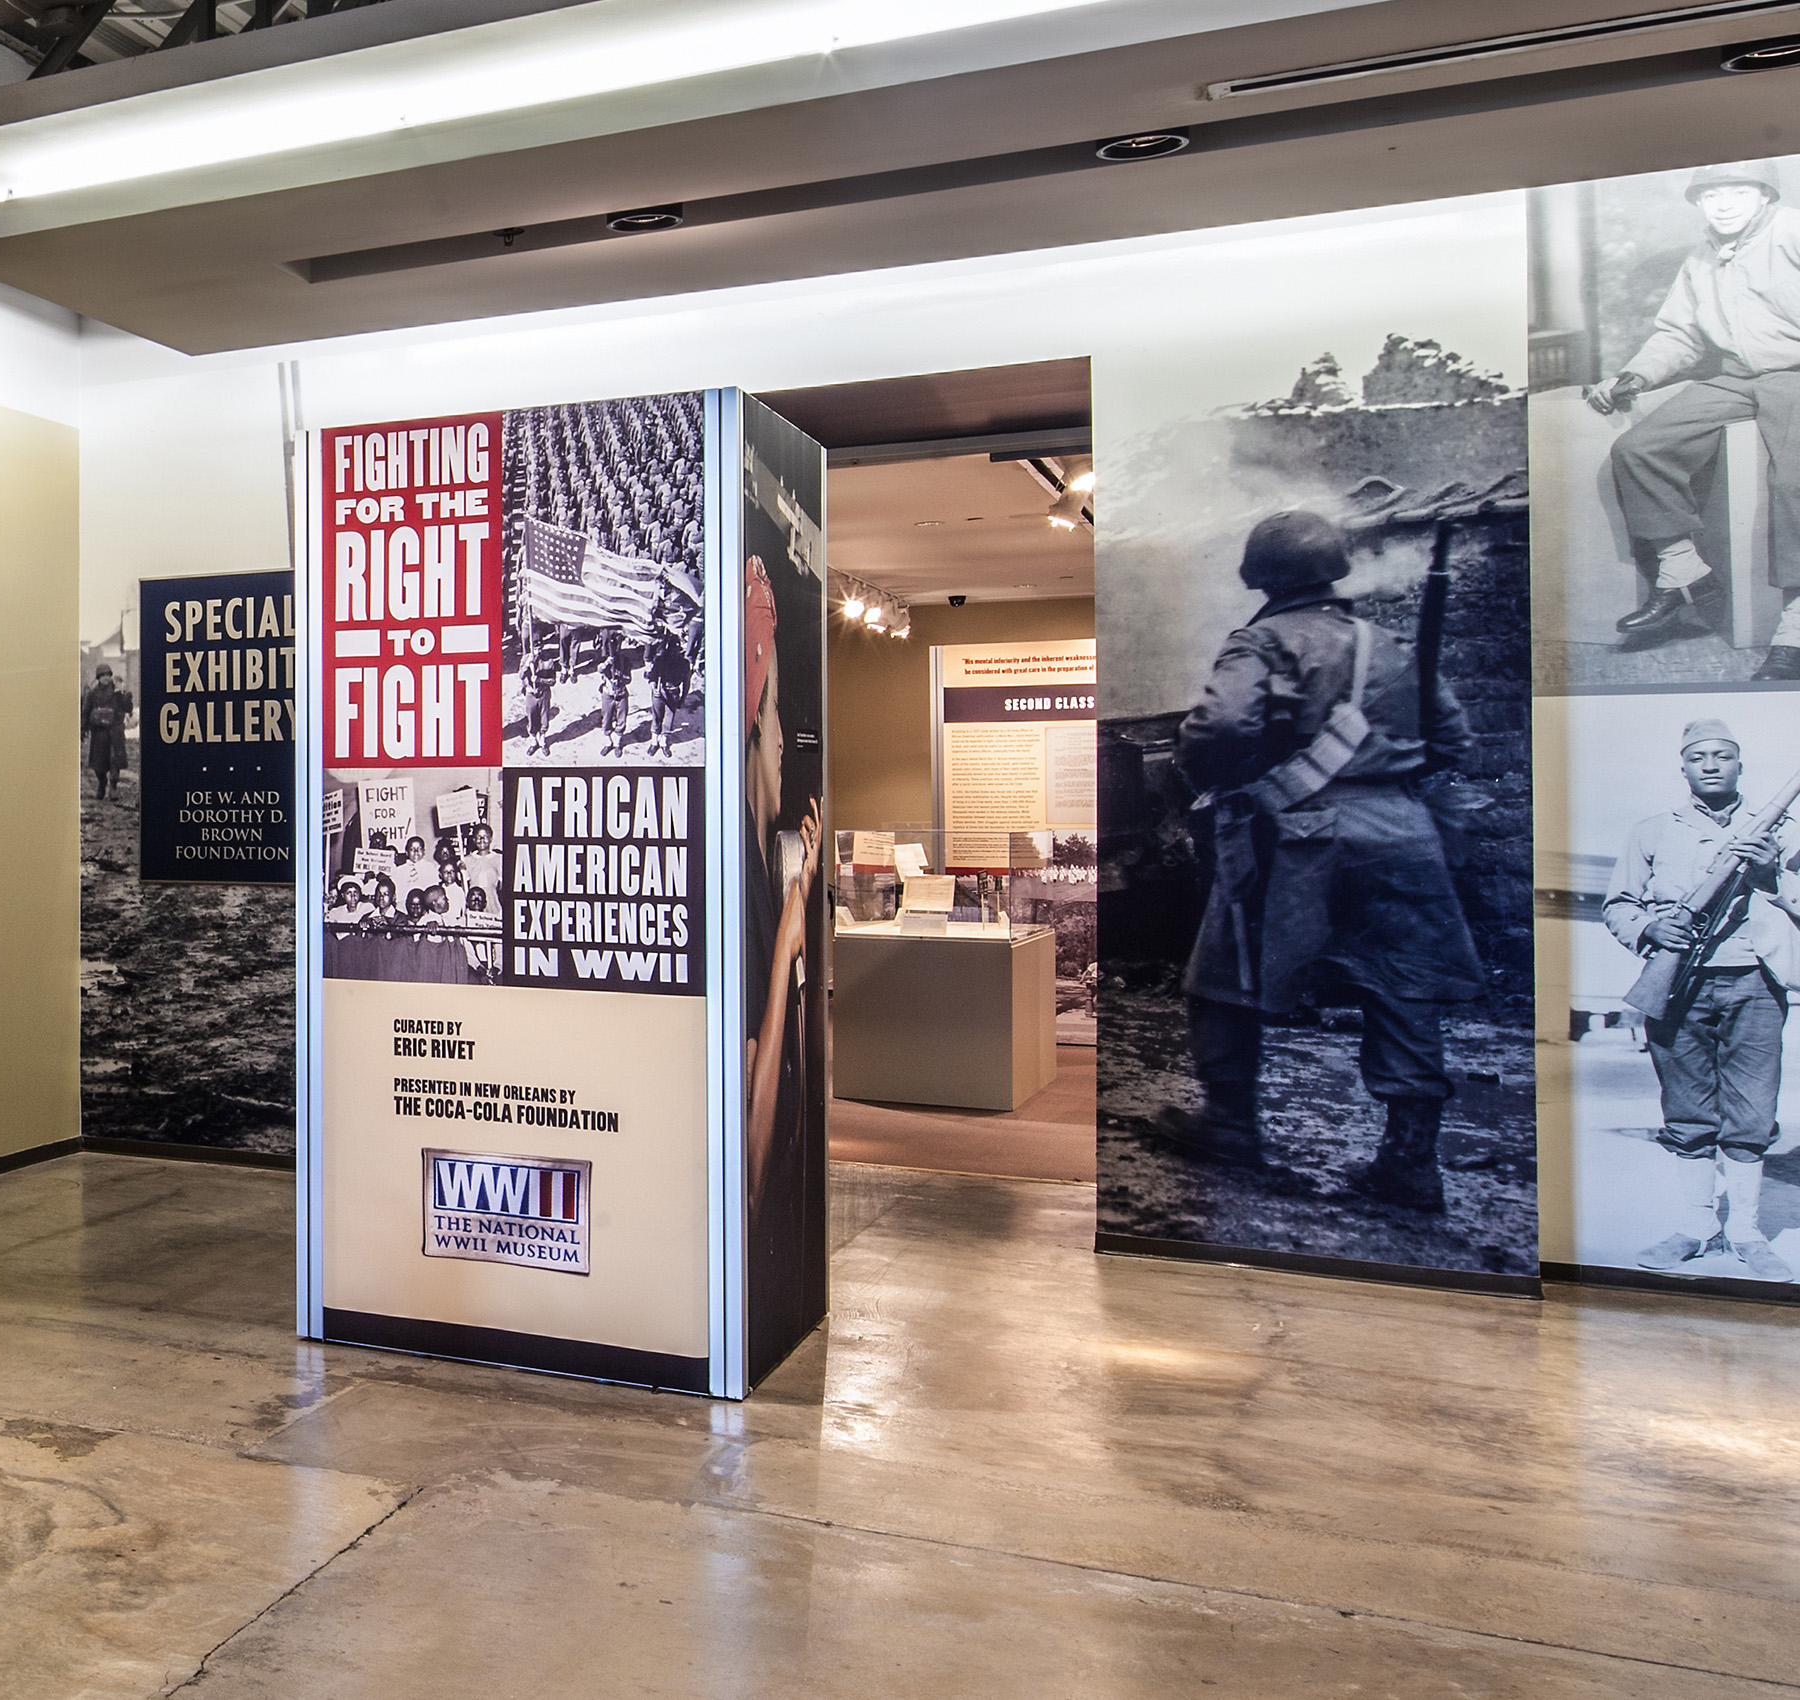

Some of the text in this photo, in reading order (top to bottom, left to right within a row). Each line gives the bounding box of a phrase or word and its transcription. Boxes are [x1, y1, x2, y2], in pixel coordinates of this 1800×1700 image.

[335, 422, 489, 493] FIGHTING
[335, 488, 488, 525] FOR THE
[335, 521, 489, 622] RIGHT
[164, 594, 295, 642] SPECIAL
[387, 628, 435, 656] TO
[166, 647, 295, 693] EXHIBIT
[335, 663, 489, 759] FIGHT
[1004, 696, 1095, 711] SECOND CLASS
[185, 790, 280, 807] JOE W. AND
[365, 786, 408, 803] FIGHT
[513, 775, 688, 839] AFRICAN
[179, 809, 287, 824] DOROTHY D.
[374, 808, 396, 819] FOR
[201, 827, 263, 843] BROWN
[175, 845, 290, 861] FOUNDATION
[513, 844, 688, 897] AMERICAN
[513, 899, 689, 947] EXPERIENCES
[514, 946, 689, 984] IN WWII
[393, 1018, 463, 1036] CURATED BY
[393, 1036, 476, 1061] ERIC RIVET
[394, 1077, 576, 1105] PRESENTED IN NEW ORLEANS BY
[394, 1096, 619, 1133] THE COCA-COLA FOUNDATION
[437, 1160, 575, 1220] WWII
[434, 1215, 581, 1245] THE NATIONAL
[434, 1234, 580, 1264] WWII MUSEUM
